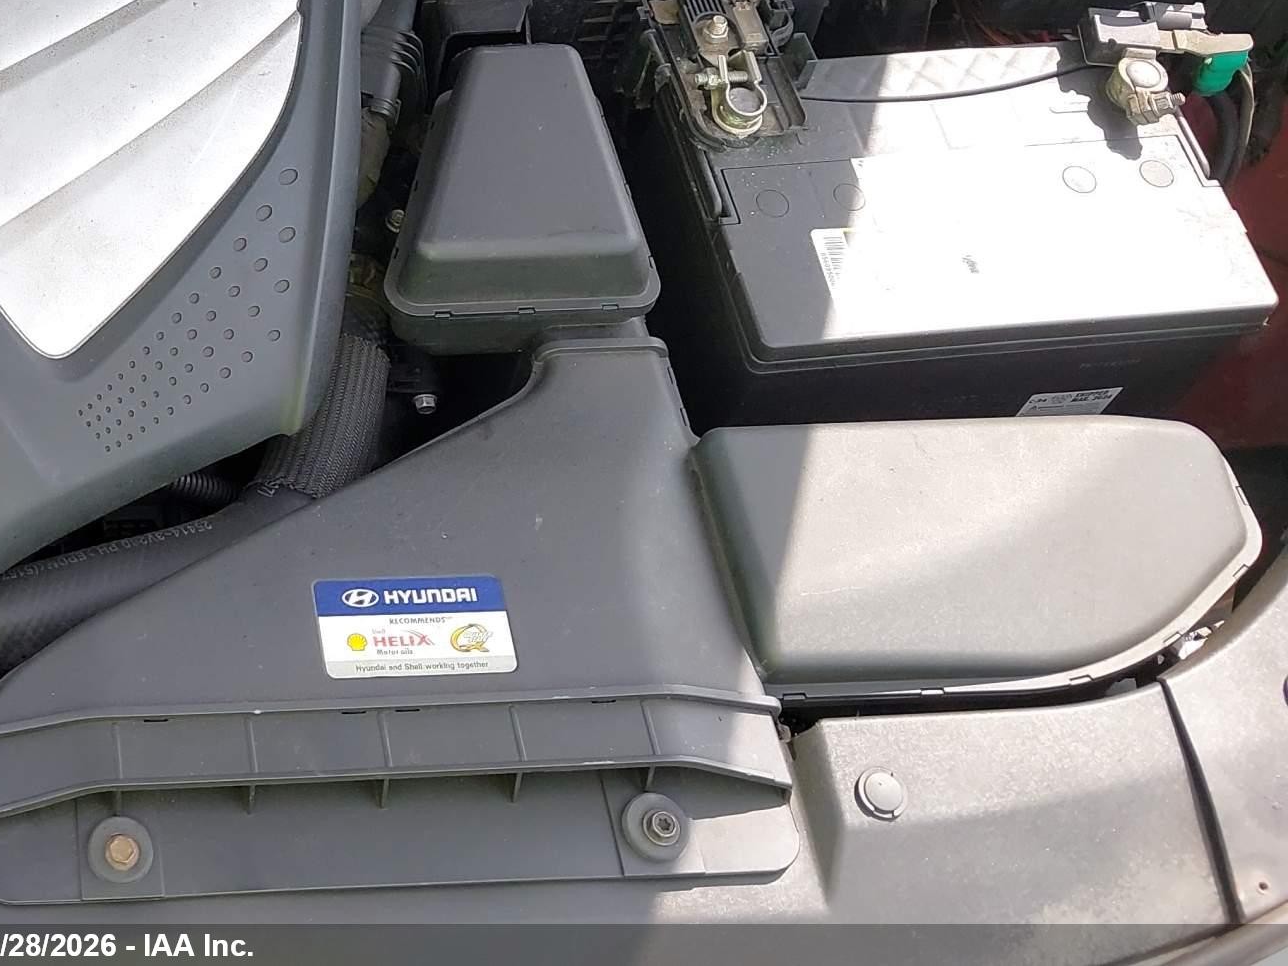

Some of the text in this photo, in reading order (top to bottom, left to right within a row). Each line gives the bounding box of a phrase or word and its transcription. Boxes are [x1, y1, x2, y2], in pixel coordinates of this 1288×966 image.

[383, 587, 478, 605] HYUNDAI
[389, 616, 446, 625] RECOMMENDS
[372, 634, 433, 647] HELIX
[355, 661, 489, 673] Hyundai and Shell working together
